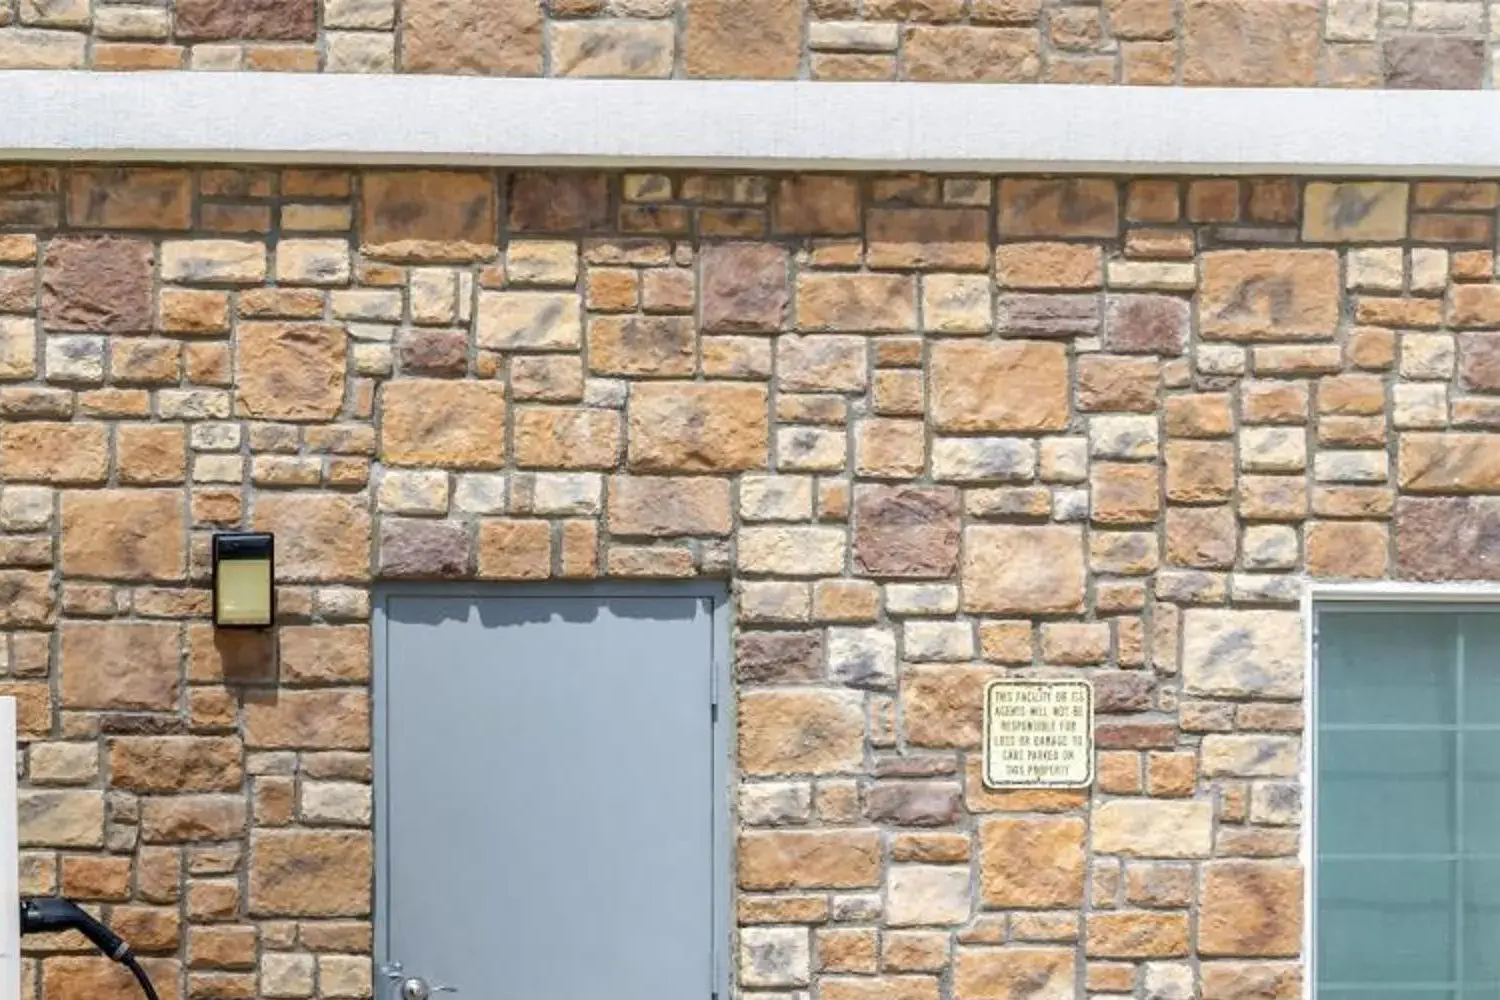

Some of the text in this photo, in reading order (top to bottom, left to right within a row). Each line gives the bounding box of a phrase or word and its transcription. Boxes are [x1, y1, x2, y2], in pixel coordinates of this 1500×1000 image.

[996, 691, 1084, 702] THIS FACILITY OR ITS
[995, 705, 1084, 716] AGENTS WILL NOT BE
[1001, 720, 1077, 732] RESPONSIBLE FOR
[994, 735, 1083, 746] LOSS OR DAMAGE TO
[1002, 750, 1074, 761] CARS PARKED ON
[1006, 764, 1069, 776] THIS PROPERTY
